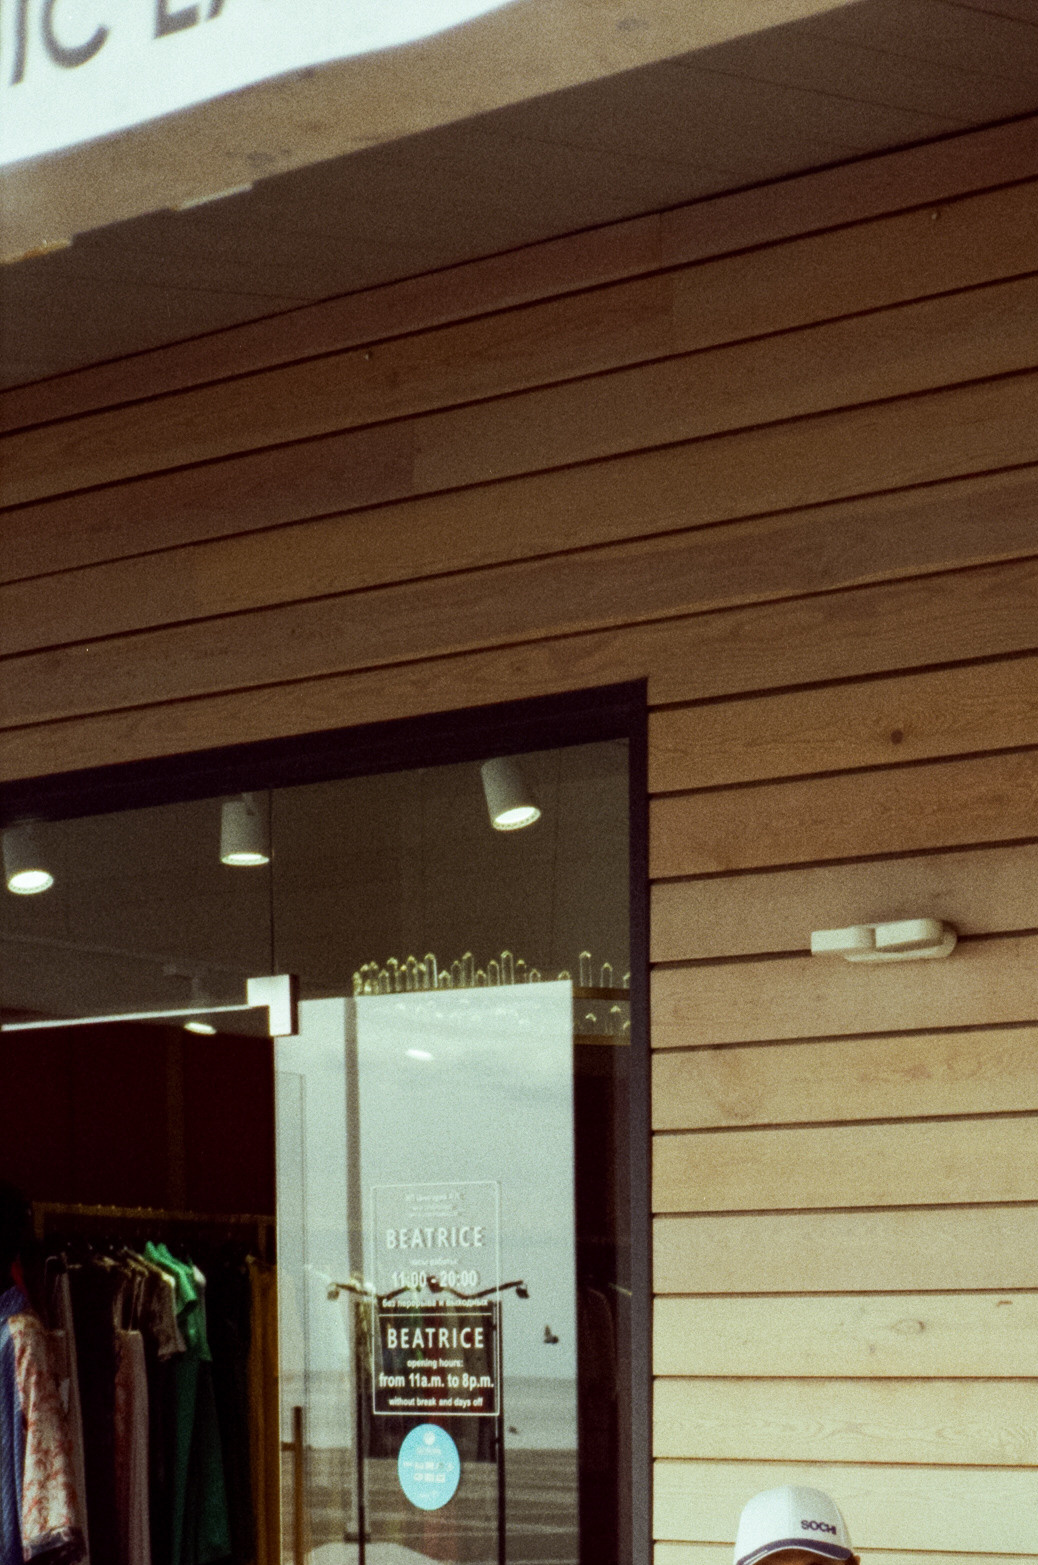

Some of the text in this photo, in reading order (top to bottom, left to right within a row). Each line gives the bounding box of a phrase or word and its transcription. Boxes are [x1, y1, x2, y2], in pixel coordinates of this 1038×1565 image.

[386, 1226, 484, 1250] BEATRICE
[392, 1270, 427, 1287] 11:00
[440, 1269, 478, 1287] 20:00
[387, 1327, 485, 1349] BEATRICE
[407, 1358, 464, 1369] opening hours:
[379, 1372, 495, 1391] from 11a.m. to 8p.m.
[388, 1397, 484, 1408] without break and days off
[801, 1519, 837, 1536] SOCHI
